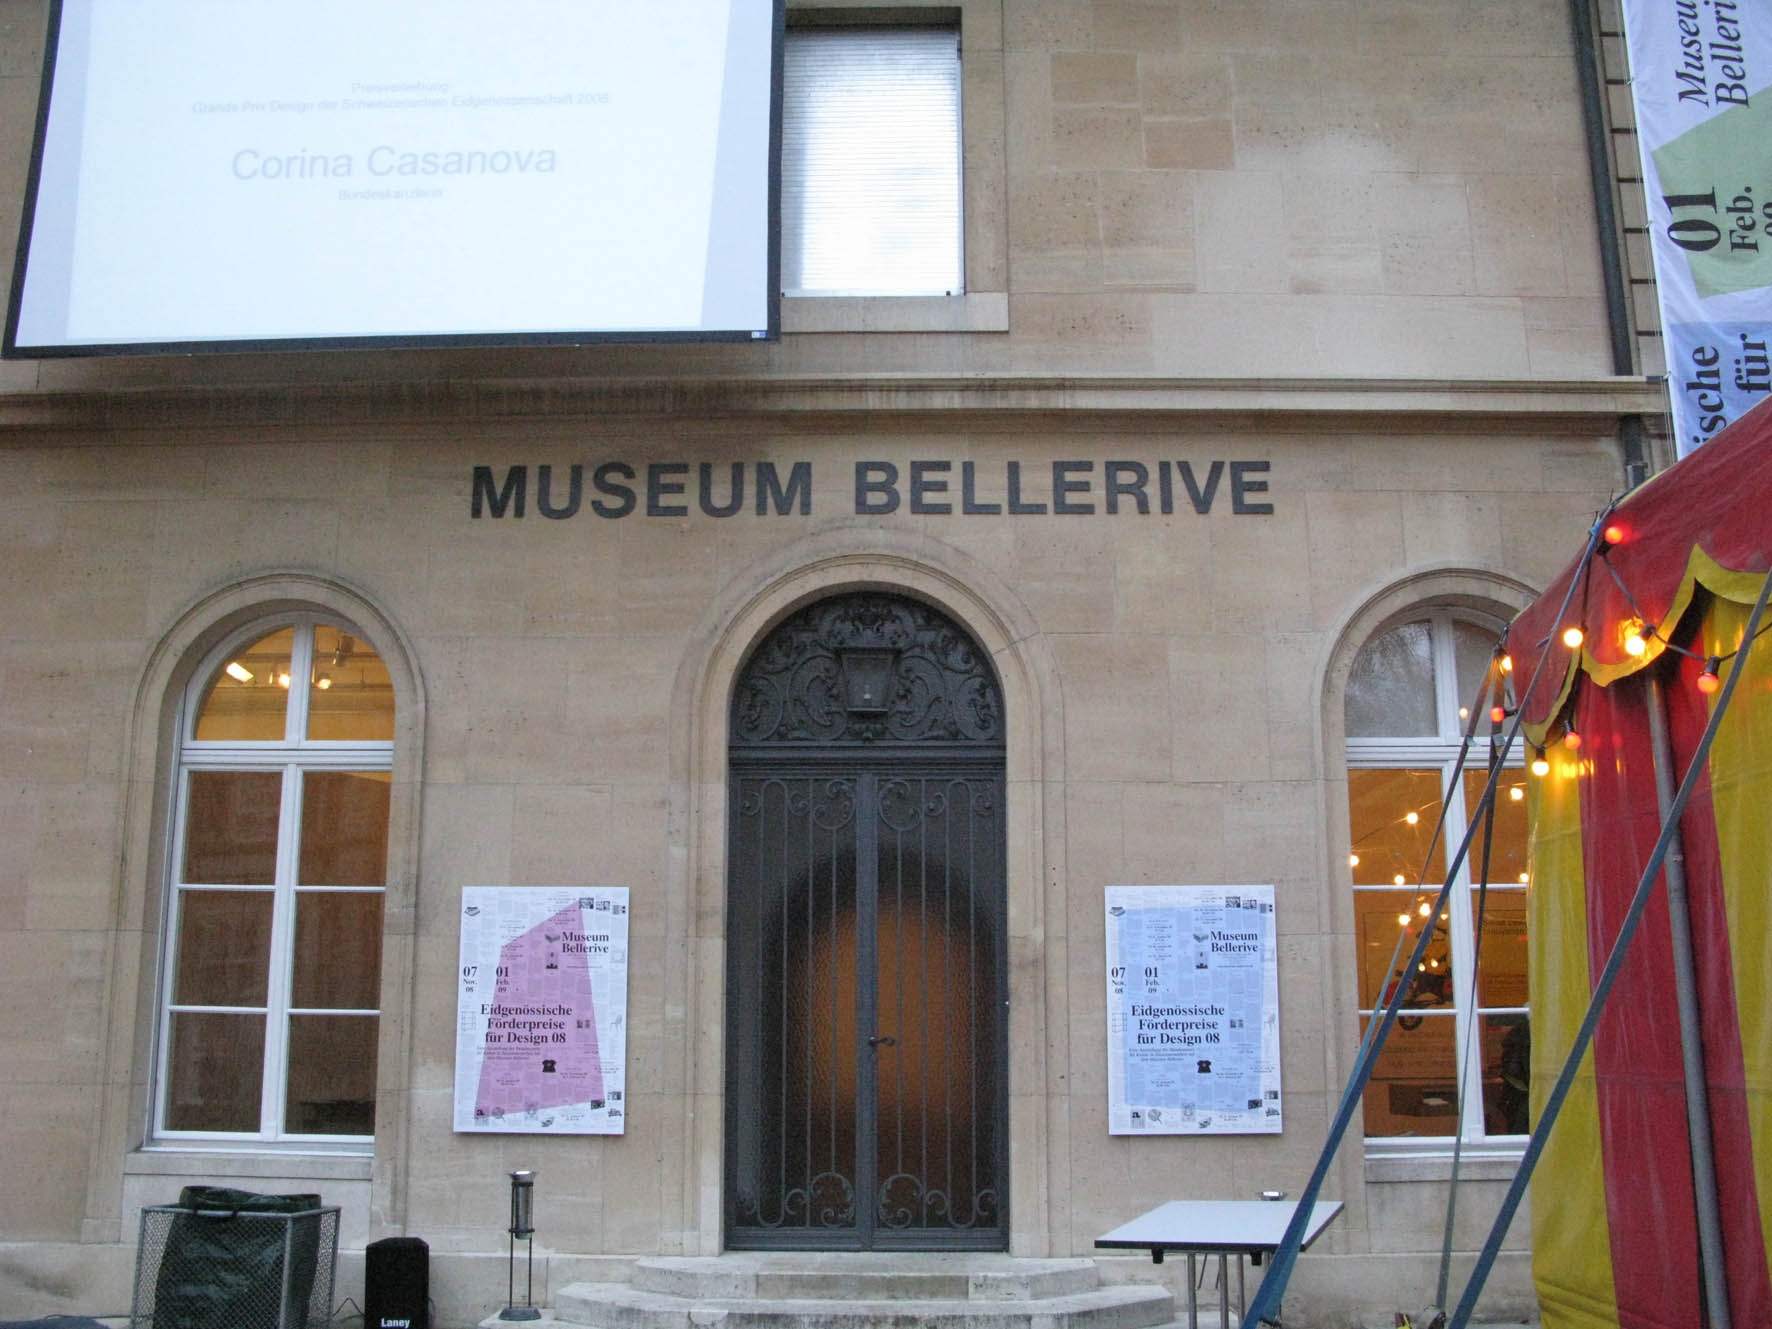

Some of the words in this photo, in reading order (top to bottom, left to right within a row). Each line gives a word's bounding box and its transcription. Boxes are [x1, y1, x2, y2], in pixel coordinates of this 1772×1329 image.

[231, 147, 353, 180] Corina
[367, 145, 556, 177] Casanova
[1662, 186, 1721, 252] 01
[1726, 186, 1759, 253] Feb.
[1734, 333, 1772, 394] für
[1686, 346, 1727, 443] sche
[469, 461, 814, 520] MUSEUM
[853, 460, 1276, 517] BELLERIVE
[562, 931, 609, 942] Museum
[1210, 931, 1258, 941] Museum
[562, 943, 609, 953] Bellerive
[1211, 942, 1258, 953] Bellerive
[463, 966, 477, 977] 07
[495, 966, 510, 977] 01
[1111, 967, 1126, 978] 07
[1144, 967, 1159, 978] 01
[481, 1003, 573, 1017] Eidgenössische
[1131, 1004, 1225, 1018] Eidgenössische
[487, 1018, 566, 1032] Förderpreise
[1139, 1018, 1219, 1032] Förderpreise
[485, 1032, 504, 1043] für
[507, 1032, 548, 1046] Design
[551, 1032, 566, 1043] 08
[1137, 1033, 1156, 1044] für
[1160, 1033, 1201, 1046] Design
[1205, 1033, 1220, 1044] 08
[381, 1318, 410, 1329] Laney
